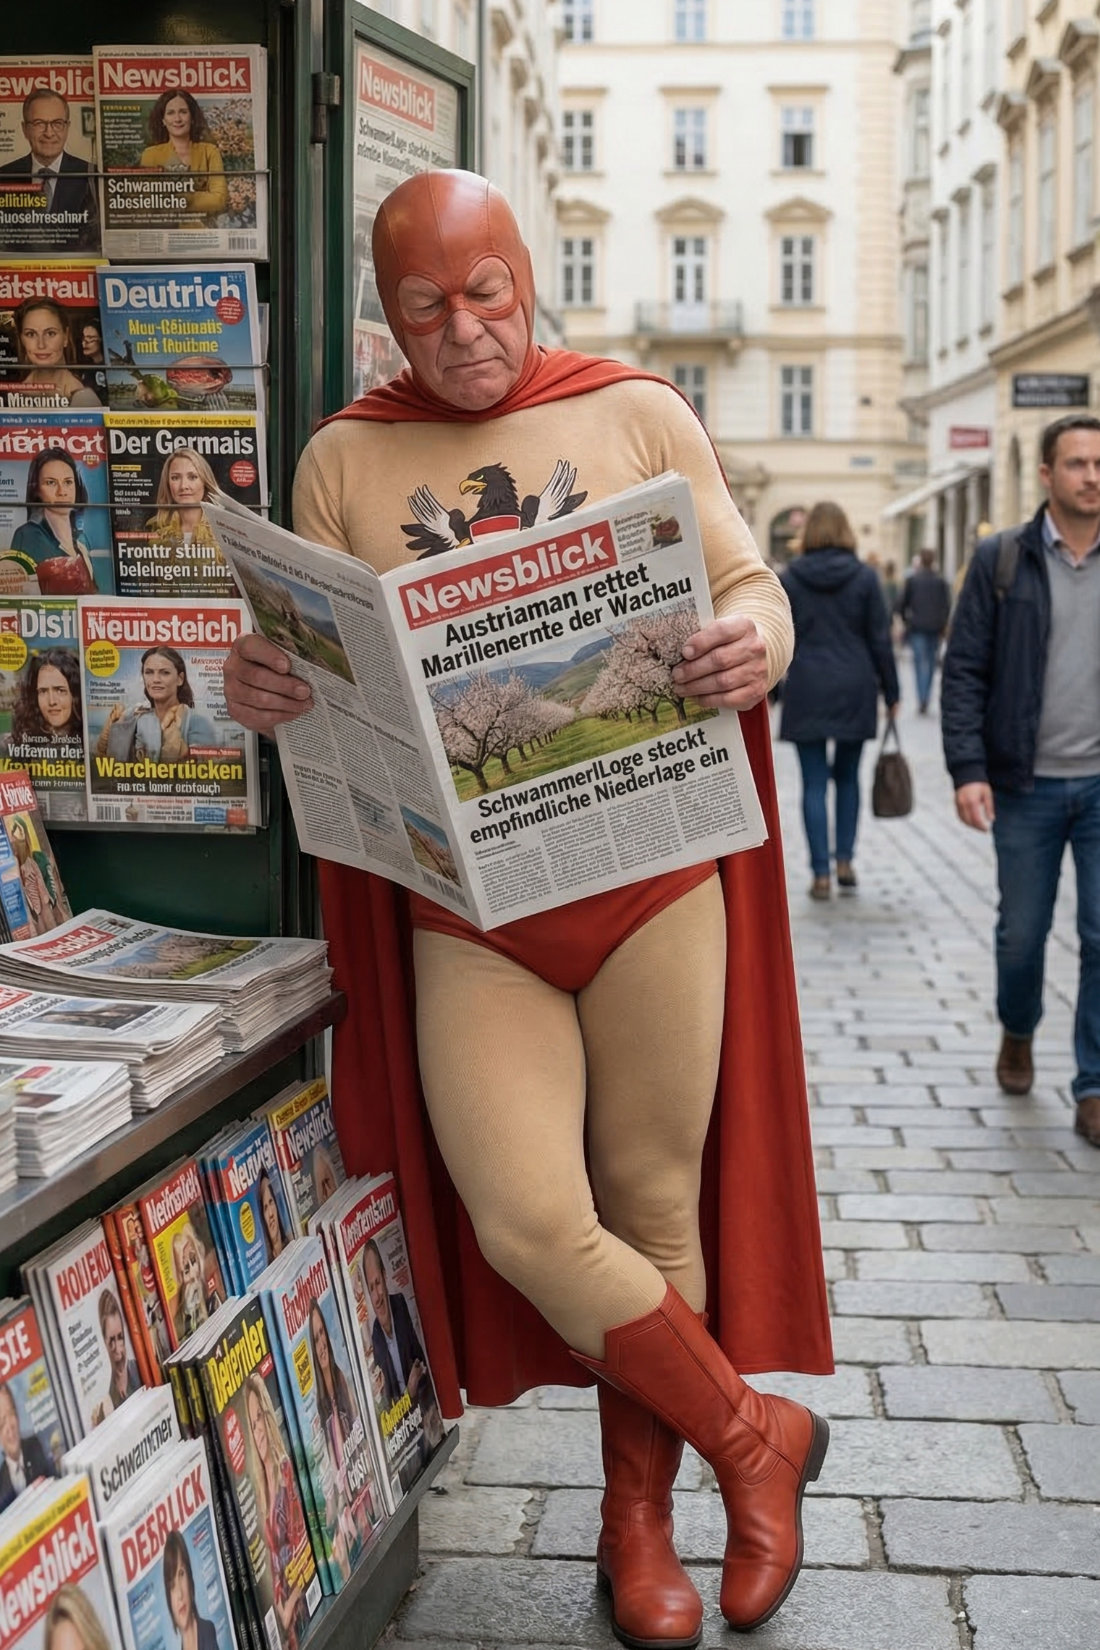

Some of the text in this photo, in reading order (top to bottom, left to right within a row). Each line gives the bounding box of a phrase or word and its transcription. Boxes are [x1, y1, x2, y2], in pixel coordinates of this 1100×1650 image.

[102, 61, 248, 89] Newsblick
[361, 62, 433, 125] Newsblick
[105, 276, 241, 309] Deutrich
[110, 429, 151, 454] Der
[155, 429, 255, 455] Germais
[404, 533, 608, 620] Newsblick
[445, 562, 650, 647] Austriaman rettet
[420, 575, 693, 680] Marillenernte der Wachau
[648, 726, 708, 762] steckt
[470, 744, 730, 844] empfindliche Niederlage ein
